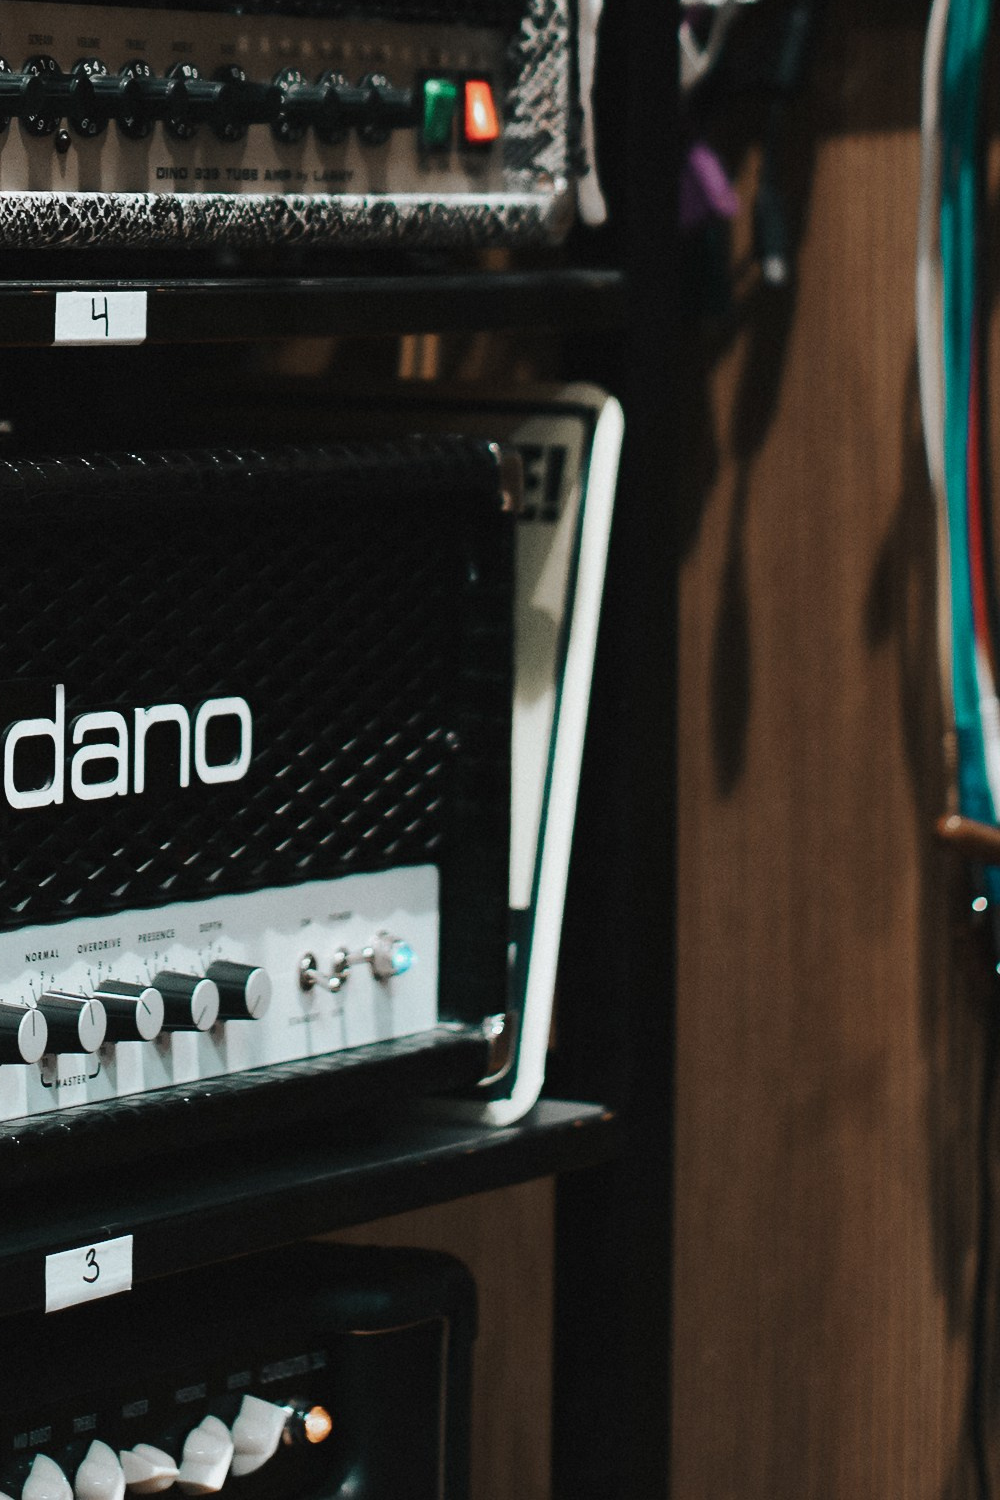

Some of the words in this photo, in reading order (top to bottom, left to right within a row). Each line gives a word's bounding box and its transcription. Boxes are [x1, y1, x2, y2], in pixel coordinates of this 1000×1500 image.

[92, 296, 109, 337] 4
[25, 949, 59, 963] NORMAL
[77, 937, 121, 954] OVERDRIVE
[138, 929, 175, 943] PRESENCE
[55, 1074, 87, 1089] MASTER
[82, 1247, 100, 1283] 3
